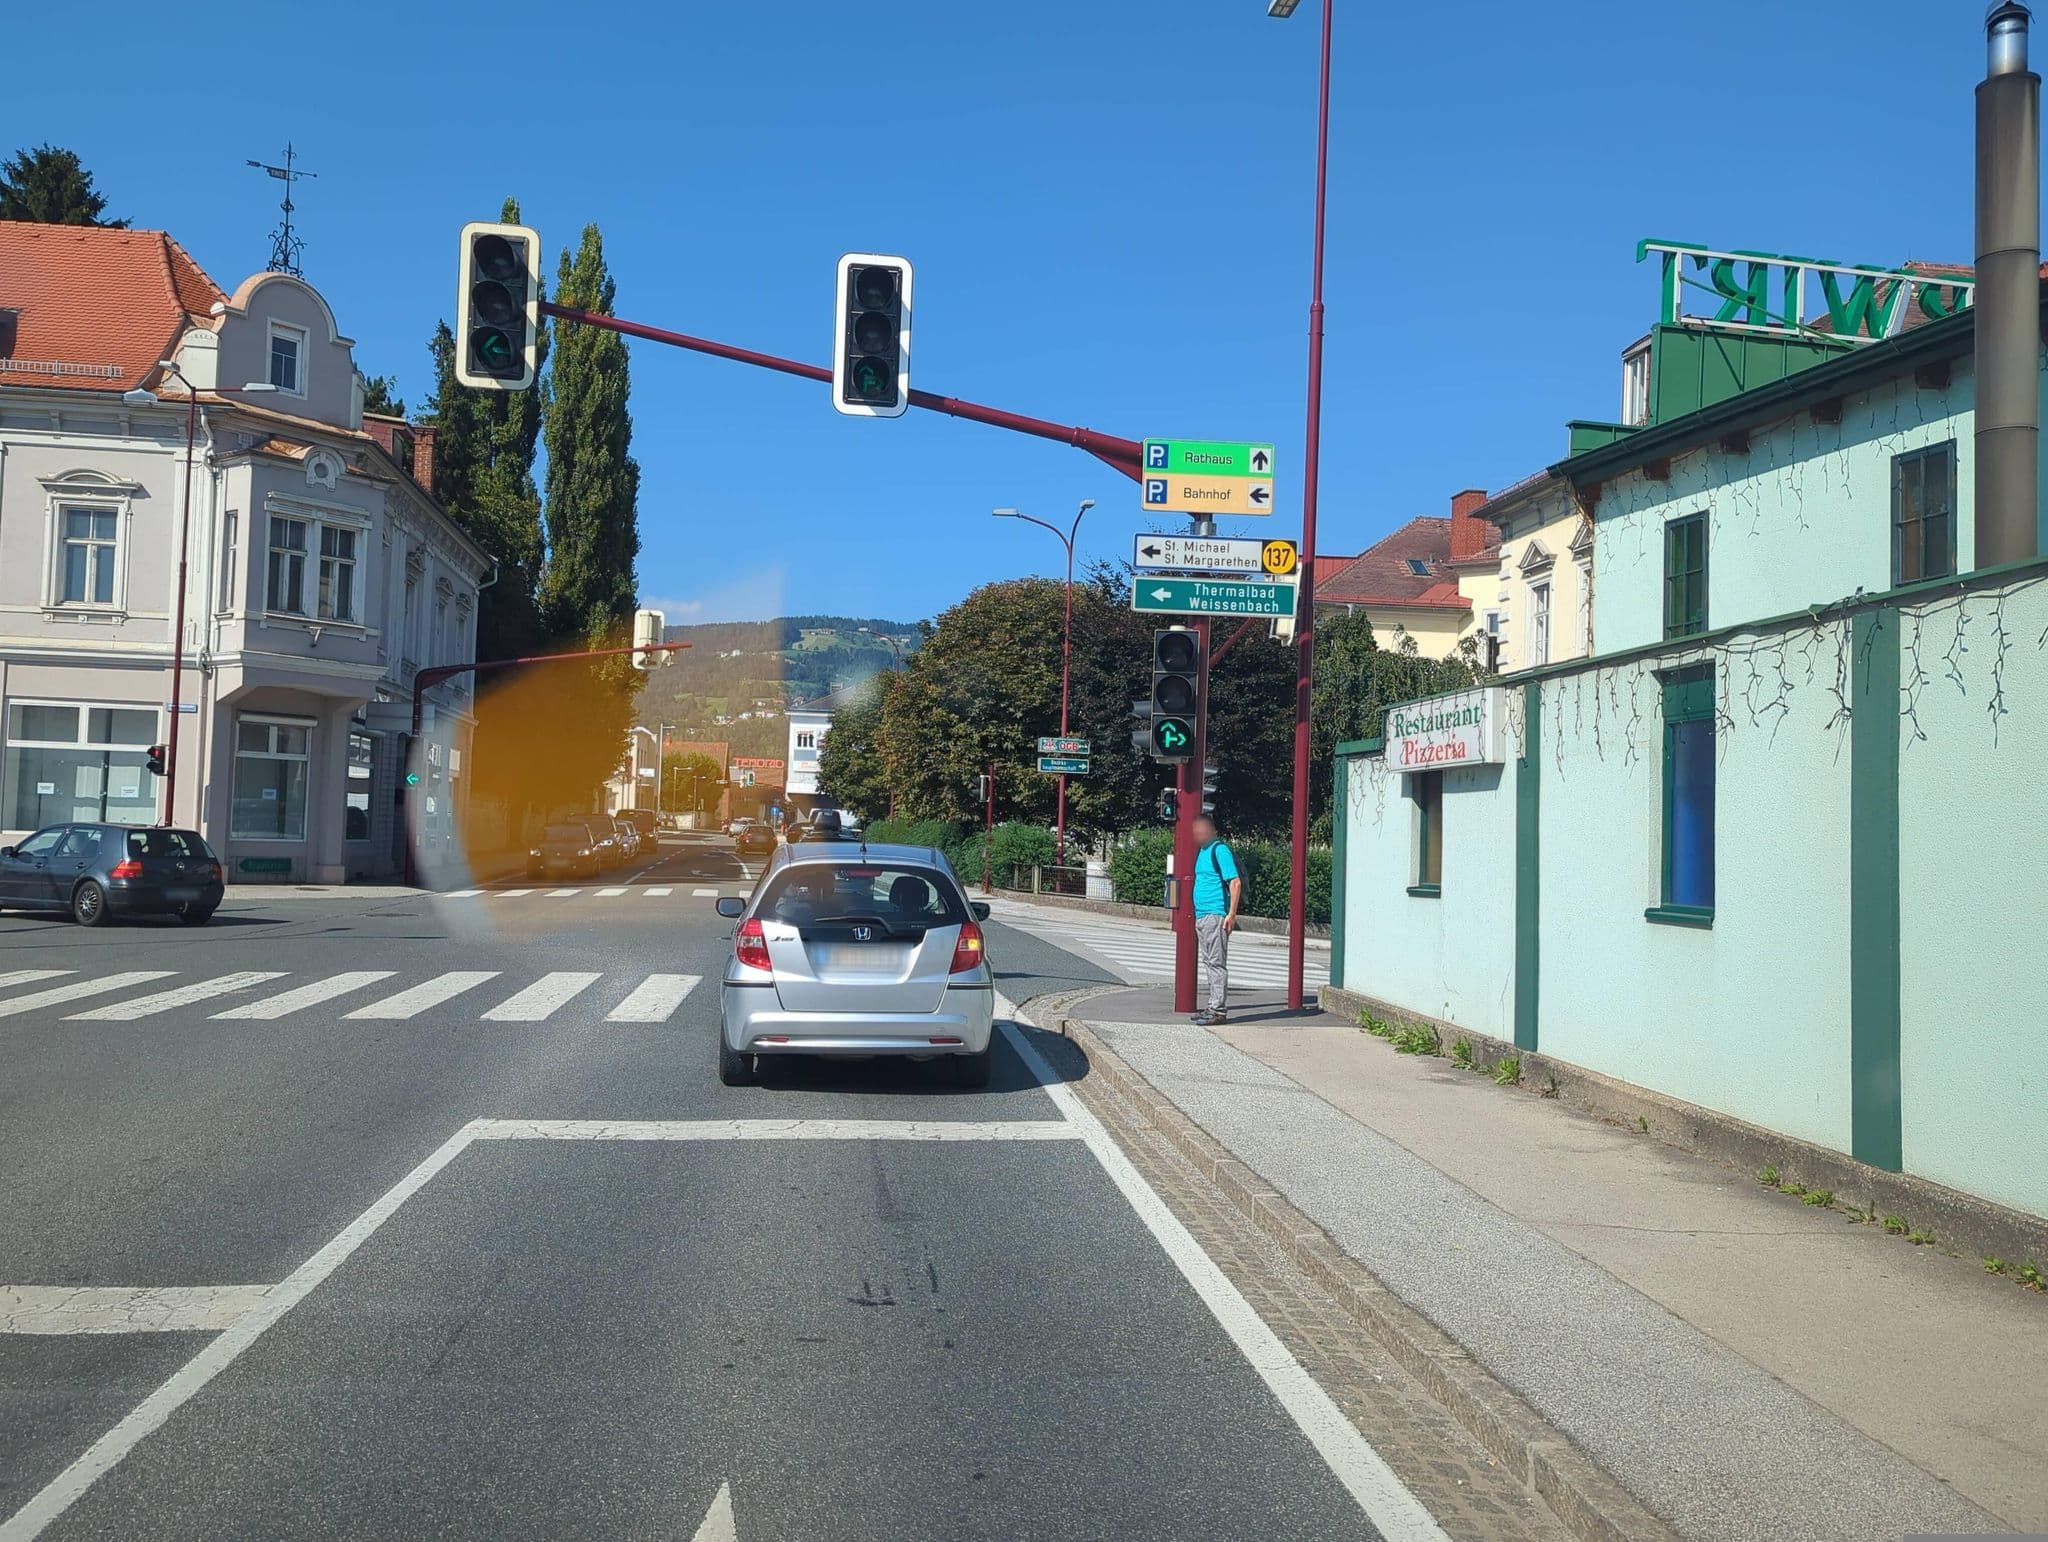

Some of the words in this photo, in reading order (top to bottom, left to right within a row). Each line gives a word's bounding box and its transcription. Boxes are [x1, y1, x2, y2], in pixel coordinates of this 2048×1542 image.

[1185, 452, 1233, 465] Rathaus
[1183, 488, 1232, 500] Bahnhof
[1165, 540, 1179, 551] St.
[1185, 541, 1230, 553] Michael
[1165, 554, 1178, 564] St.
[1183, 555, 1258, 568] Margarethen
[1266, 548, 1290, 567] 137
[1194, 583, 1275, 599] Thermalbad
[1189, 597, 1279, 612] Weissenbach
[1394, 704, 1481, 738] Restaurant
[1403, 733, 1466, 765] Pizzeria
